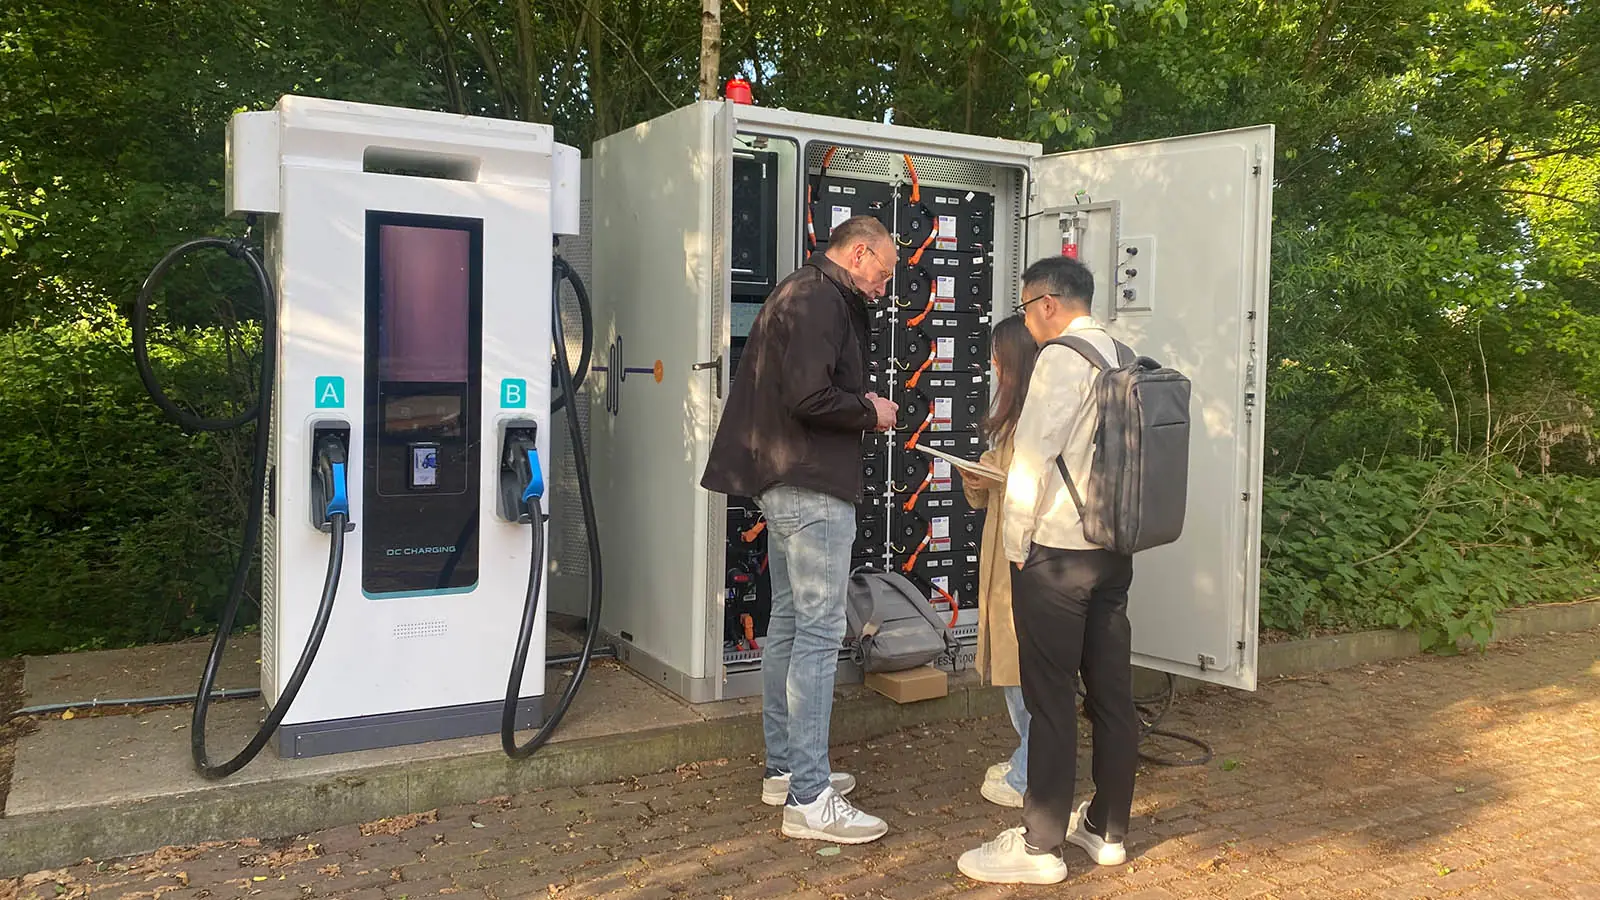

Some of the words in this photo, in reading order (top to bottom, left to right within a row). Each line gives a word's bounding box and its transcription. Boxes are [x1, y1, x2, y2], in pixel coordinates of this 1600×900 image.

[320, 382, 340, 403] A
[506, 384, 521, 403] B
[386, 548, 402, 556] DC
[403, 545, 457, 555] CHARGING
